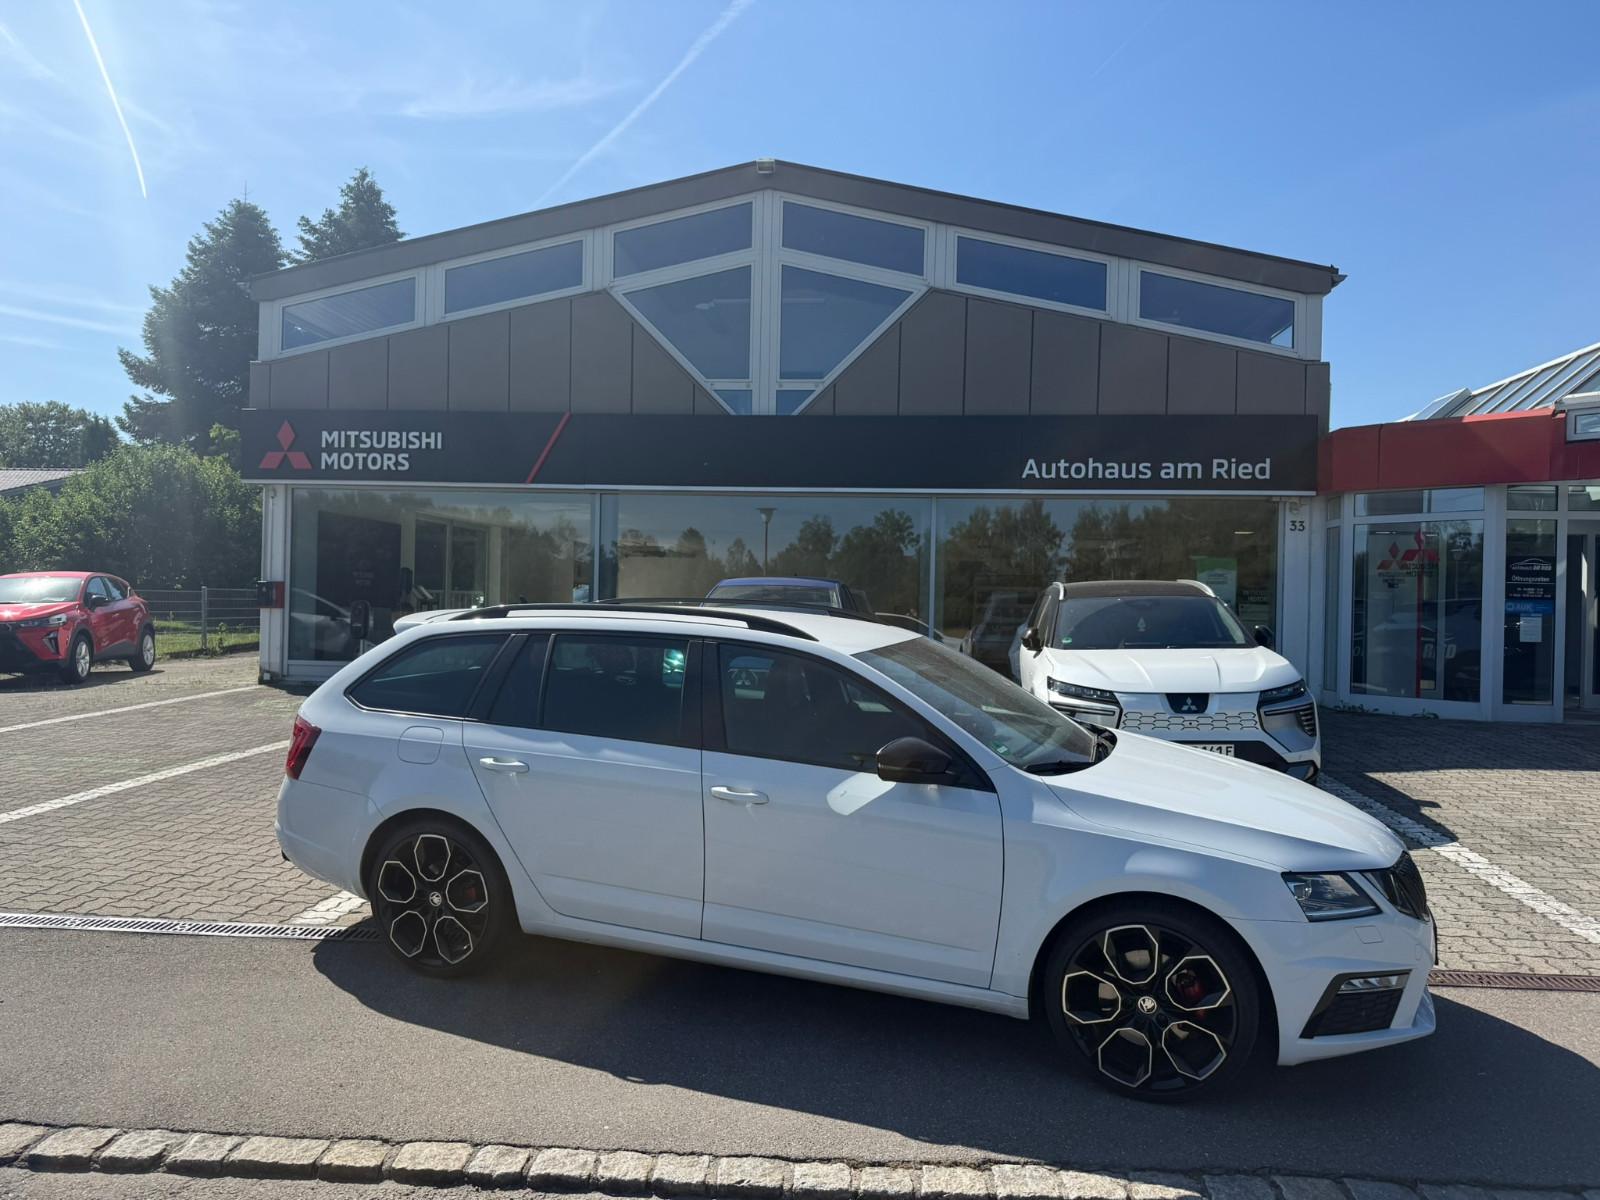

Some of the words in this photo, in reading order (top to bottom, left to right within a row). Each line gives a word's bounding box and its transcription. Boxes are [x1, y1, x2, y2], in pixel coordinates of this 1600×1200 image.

[321, 430, 442, 449] MITSUBISHI
[321, 452, 410, 471] MOTORS
[1021, 457, 1153, 480] Autohaus
[1160, 462, 1203, 480] am
[1212, 457, 1272, 480] Ried
[1289, 520, 1306, 532] 33
